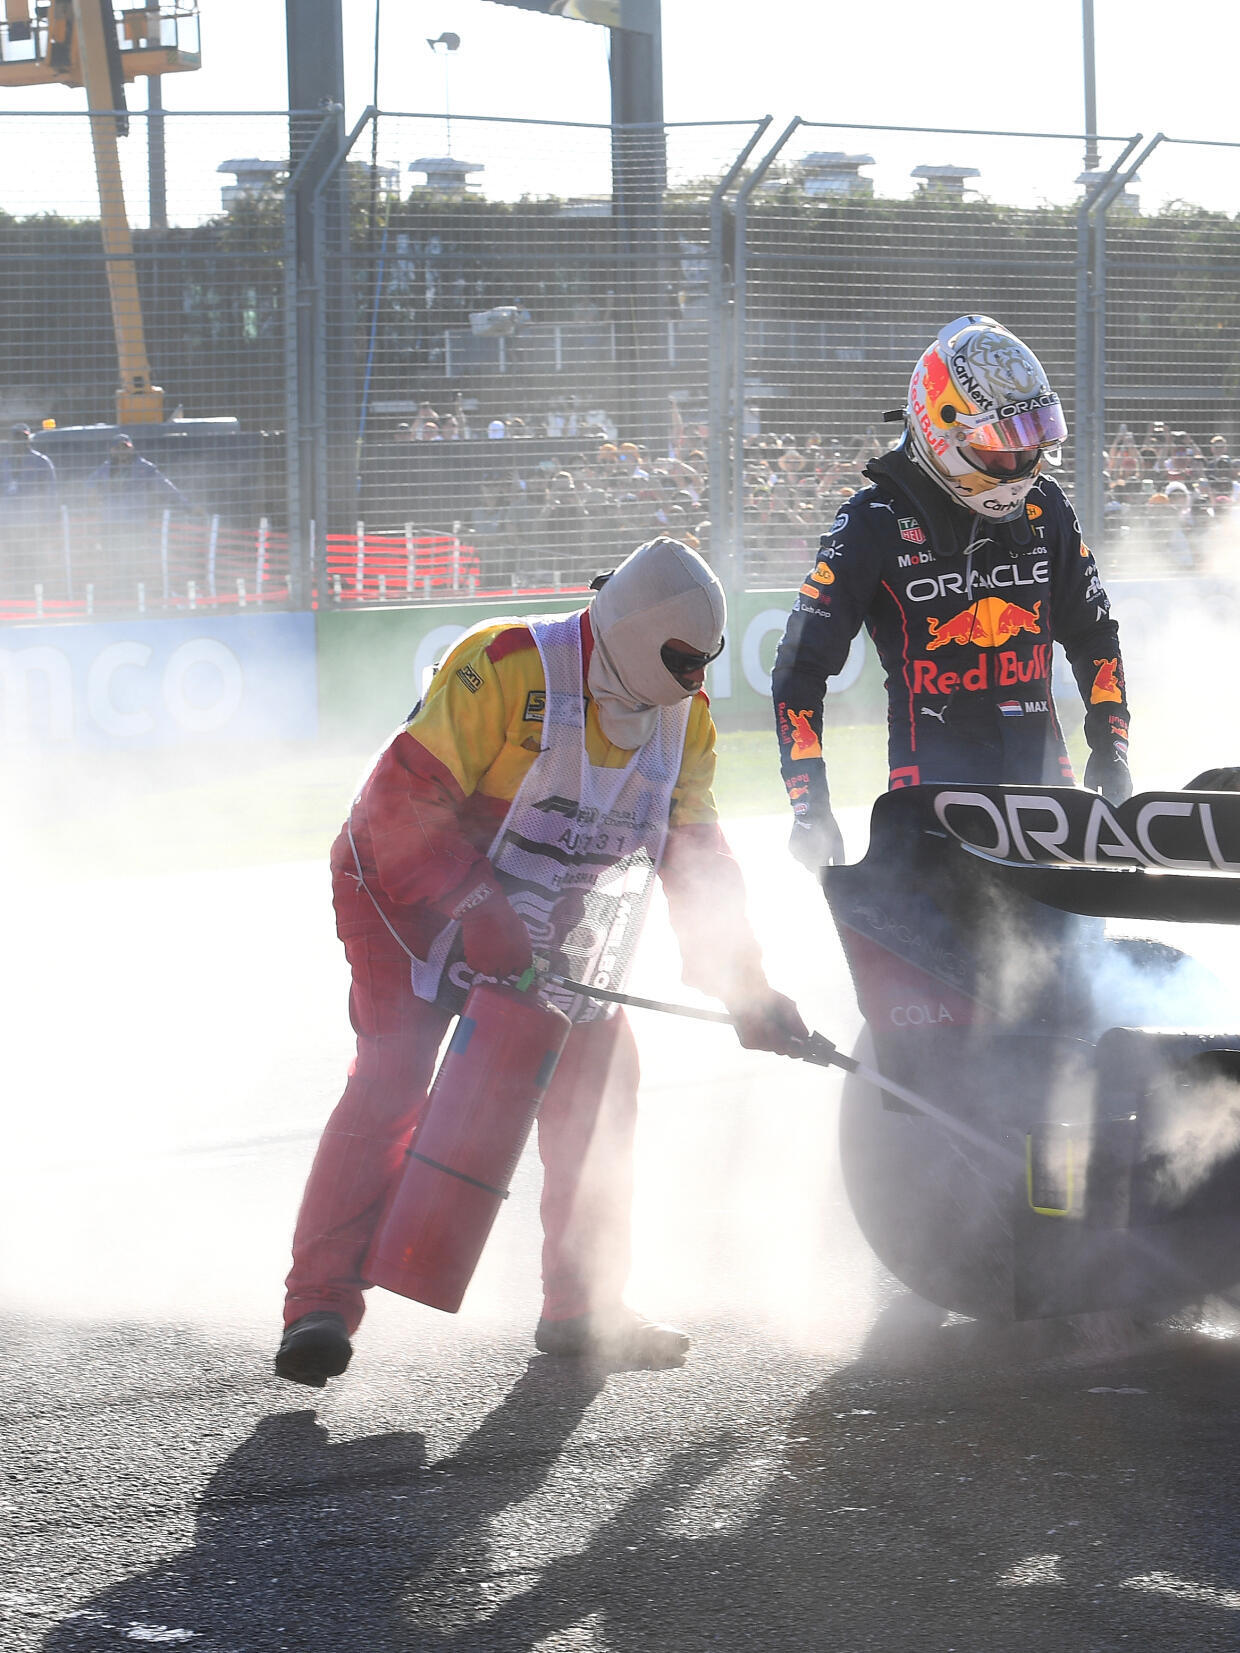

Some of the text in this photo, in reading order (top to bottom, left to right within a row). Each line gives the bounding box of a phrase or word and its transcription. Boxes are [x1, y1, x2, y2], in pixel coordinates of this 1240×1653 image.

[953, 354, 993, 411] CarNext
[911, 371, 951, 456] Red Bull
[983, 499, 1020, 511] CarN
[900, 519, 920, 529] TA
[897, 550, 937, 568] Mobi
[905, 560, 1050, 602] ORACLE
[913, 653, 989, 695] Red
[997, 643, 1048, 687] Bull
[1025, 701, 1049, 714] MAX
[890, 1002, 955, 1027] COLA
